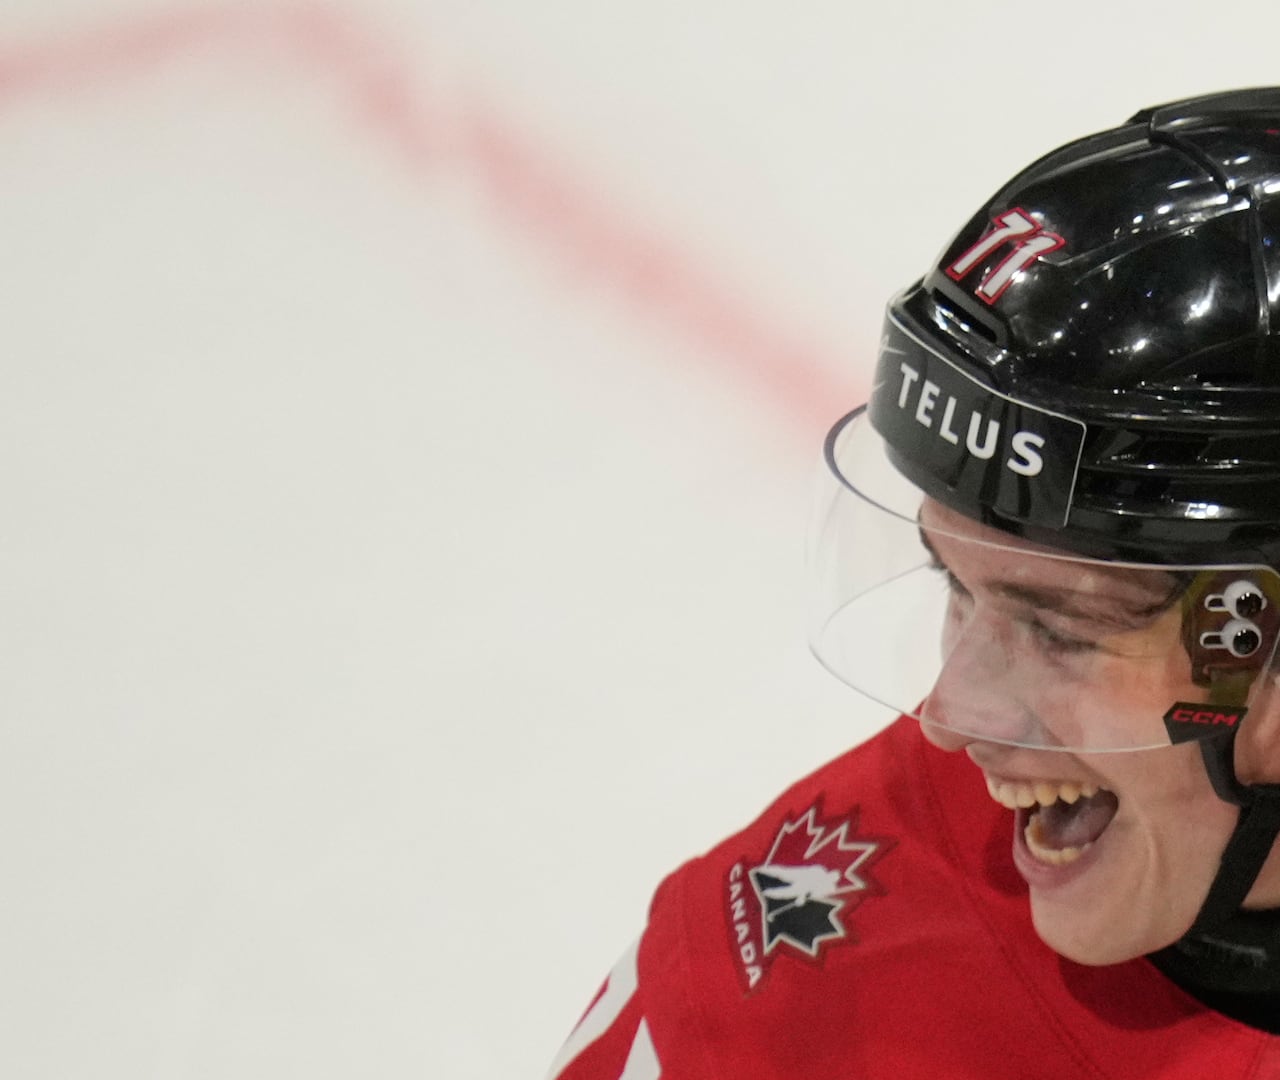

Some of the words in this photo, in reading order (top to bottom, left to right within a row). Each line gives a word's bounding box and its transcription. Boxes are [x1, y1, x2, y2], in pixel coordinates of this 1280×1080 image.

[946, 207, 1066, 305] 71
[898, 363, 1046, 476] TELUS
[1172, 709, 1239, 727] CCM
[729, 862, 762, 988] CANADA
